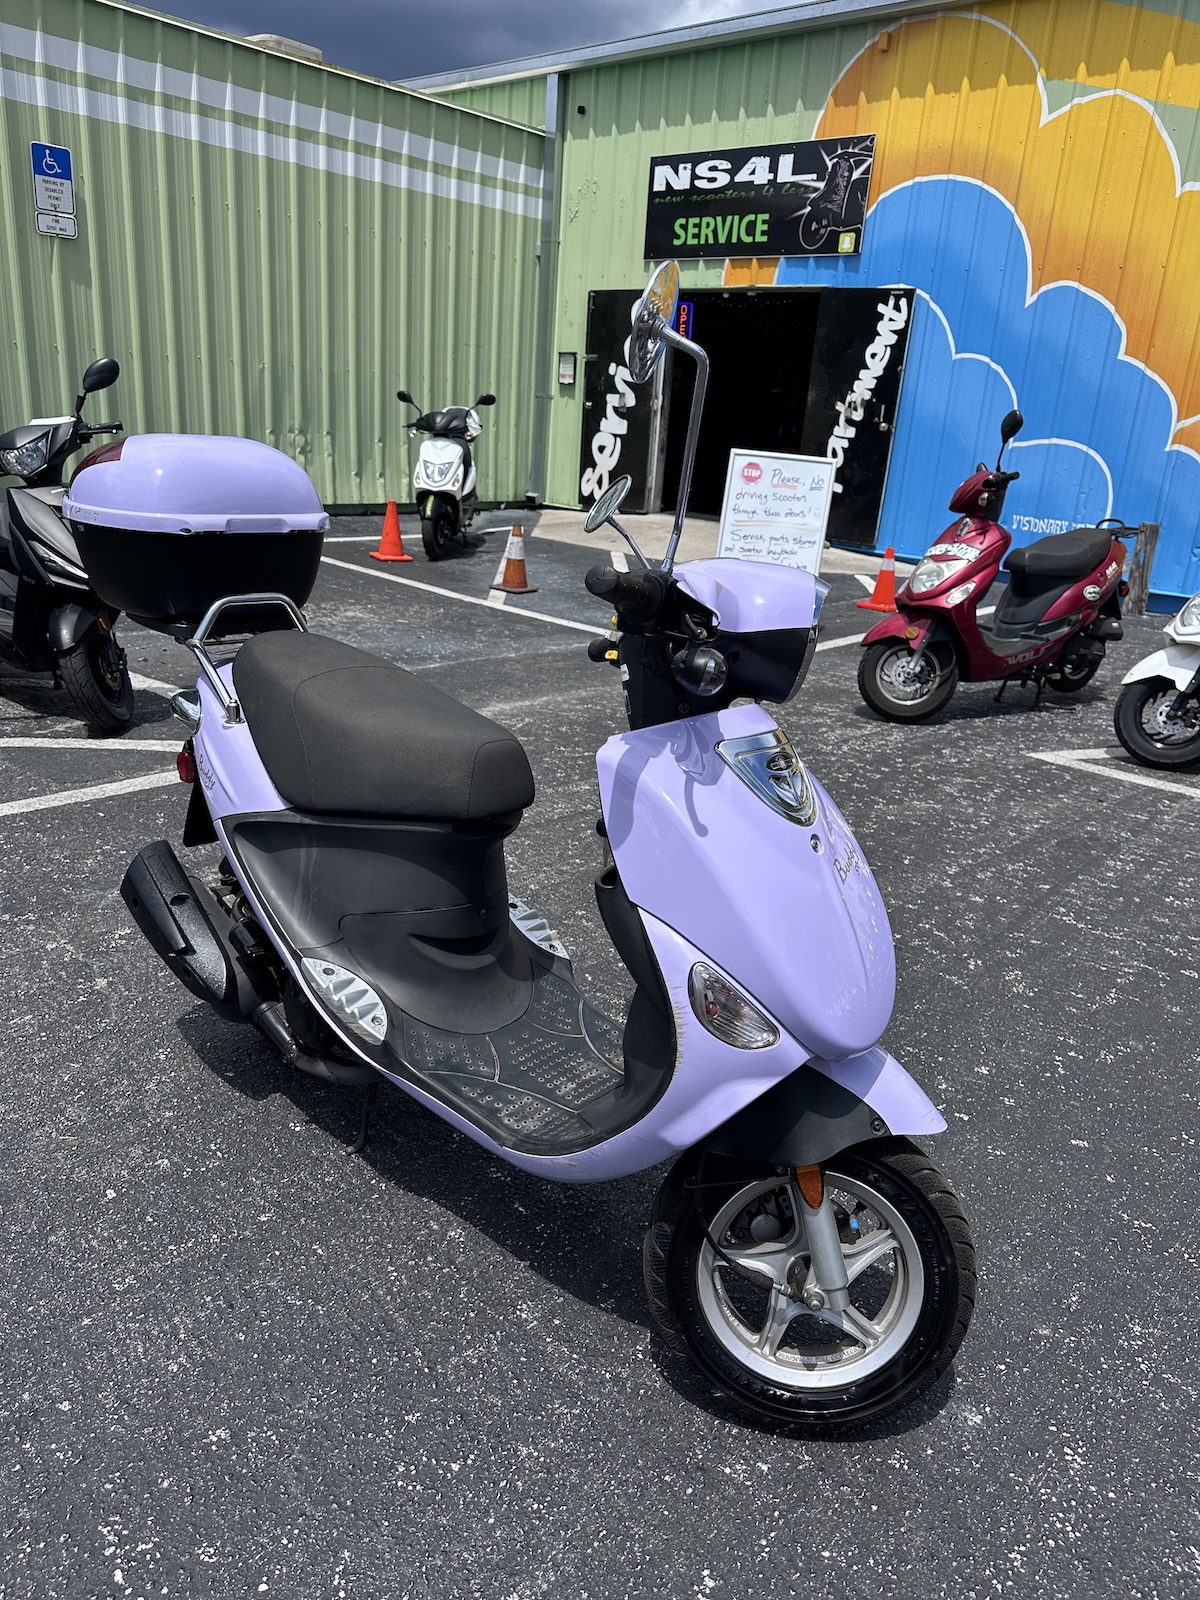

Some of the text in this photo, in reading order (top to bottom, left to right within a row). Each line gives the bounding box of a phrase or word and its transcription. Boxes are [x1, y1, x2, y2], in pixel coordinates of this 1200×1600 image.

[653, 153, 818, 192] NS4L
[653, 195, 685, 204] new
[689, 189, 757, 202] scooters
[762, 184, 775, 197] 4
[672, 213, 770, 246] SERVICE
[679, 304, 688, 338] OPE
[581, 298, 642, 500] servi
[827, 295, 908, 493] artment
[743, 468, 761, 478] STOP
[735, 488, 768, 505] driving
[732, 503, 759, 519] through
[764, 507, 781, 517] these
[1012, 514, 1069, 534] VISIONARY
